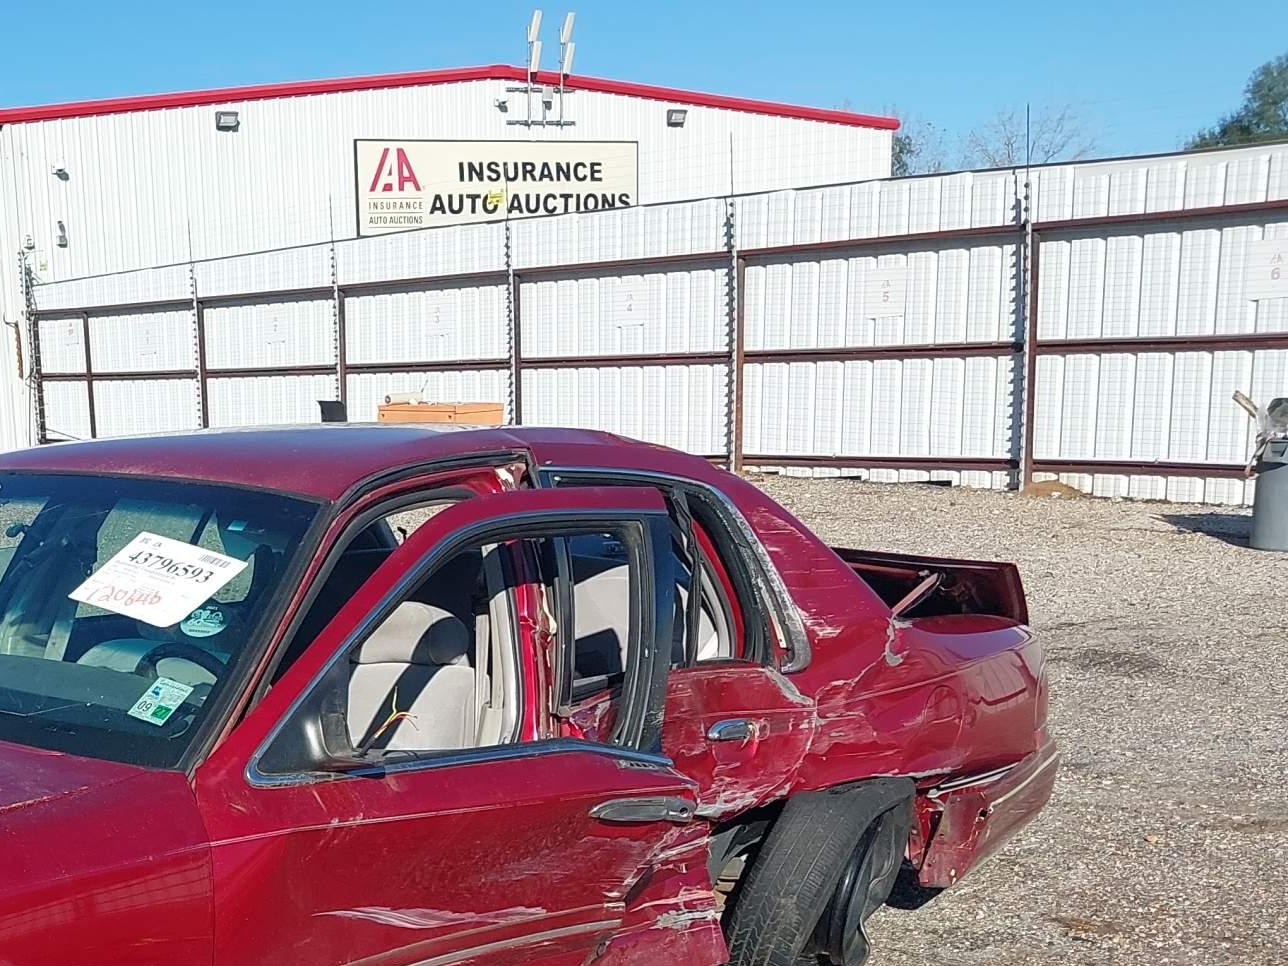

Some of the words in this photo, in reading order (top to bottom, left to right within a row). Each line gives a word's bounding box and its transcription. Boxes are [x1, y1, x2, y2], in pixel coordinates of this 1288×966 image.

[458, 161, 603, 183] INSURANCE
[368, 201, 423, 211] INSURANCE
[429, 192, 500, 215] AUTO
[507, 192, 631, 215] AUCTIONS
[368, 215, 388, 225] AUTO
[389, 214, 424, 225] AUCTIONS
[1271, 266, 1281, 281] 6
[882, 290, 890, 303] 5
[128, 550, 215, 584] 43796593
[136, 700, 153, 712] 09
